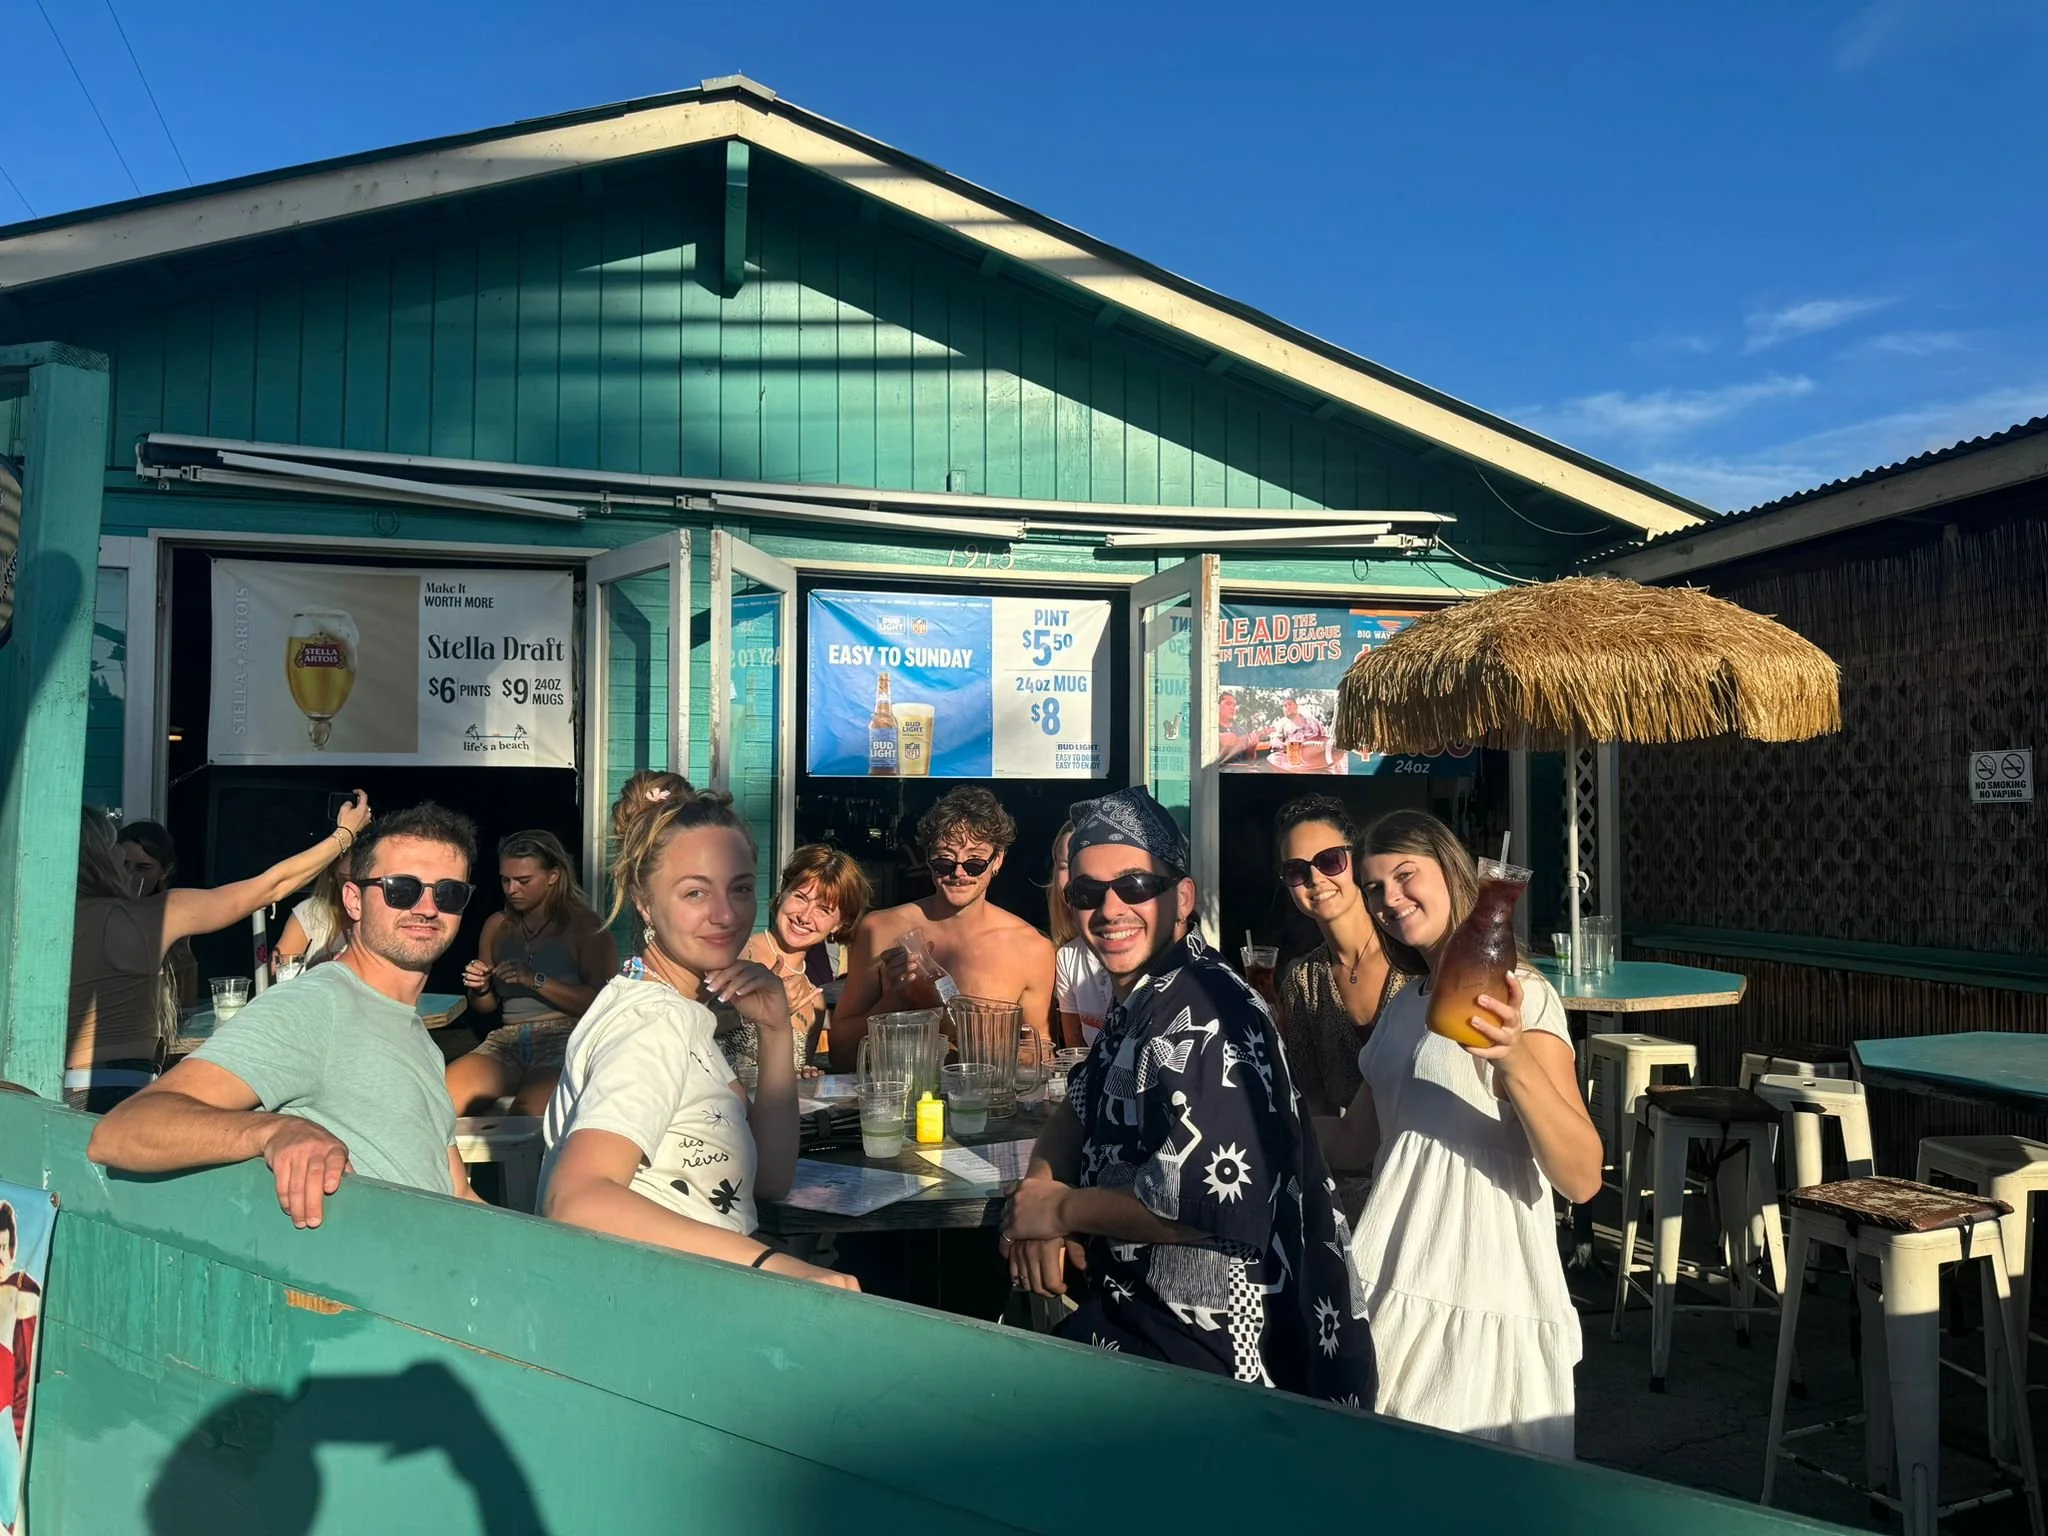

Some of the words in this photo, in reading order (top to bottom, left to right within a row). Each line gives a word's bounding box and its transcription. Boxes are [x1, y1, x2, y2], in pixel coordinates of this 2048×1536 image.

[425, 582, 456, 594] Make
[458, 583, 466, 594] It
[424, 596, 462, 608] WORTH
[464, 597, 494, 609] MORE
[234, 587, 250, 650] ARTOIS
[1034, 609, 1069, 626] PINT
[1219, 614, 1291, 647] LEAD
[1292, 613, 1318, 628] THE
[1292, 625, 1342, 642] LEAGUE
[1357, 629, 1372, 639] BIG
[304, 648, 338, 656] STELLA
[428, 633, 496, 661] Stella
[502, 635, 565, 662] Draft
[1219, 649, 1232, 663] IN
[1234, 639, 1342, 668] TIMEOUTS
[304, 655, 339, 663] ARTOIS
[828, 644, 875, 665] EASY
[877, 646, 901, 667] TO
[904, 647, 973, 669] SUNDAY
[428, 676, 456, 704] $6
[460, 685, 491, 697] PINTS
[502, 677, 529, 705] $9
[1015, 677, 1051, 694] 24oz
[1053, 675, 1088, 692] MUG
[232, 672, 248, 735] STELLA
[532, 693, 564, 706] MUGS
[1031, 697, 1061, 736] $8
[463, 741, 488, 752] life's
[499, 741, 530, 751] beach
[872, 741, 894, 750] BUD
[1057, 743, 1074, 751] BUD
[870, 749, 897, 758] LIGHT
[1055, 753, 1071, 762] EASY
[1072, 754, 1081, 762] TO
[1081, 754, 1101, 762] DRINK
[1055, 761, 1071, 770] EASY
[1072, 761, 1081, 770] TO
[1080, 761, 1101, 770] ENJOY
[1394, 760, 1431, 774] 24oz
[1975, 782, 1986, 790] NO
[1987, 780, 2026, 789] SMOKING
[1979, 790, 1990, 798] NO
[1991, 789, 2022, 798] VAPING
[678, 1137, 704, 1149] des
